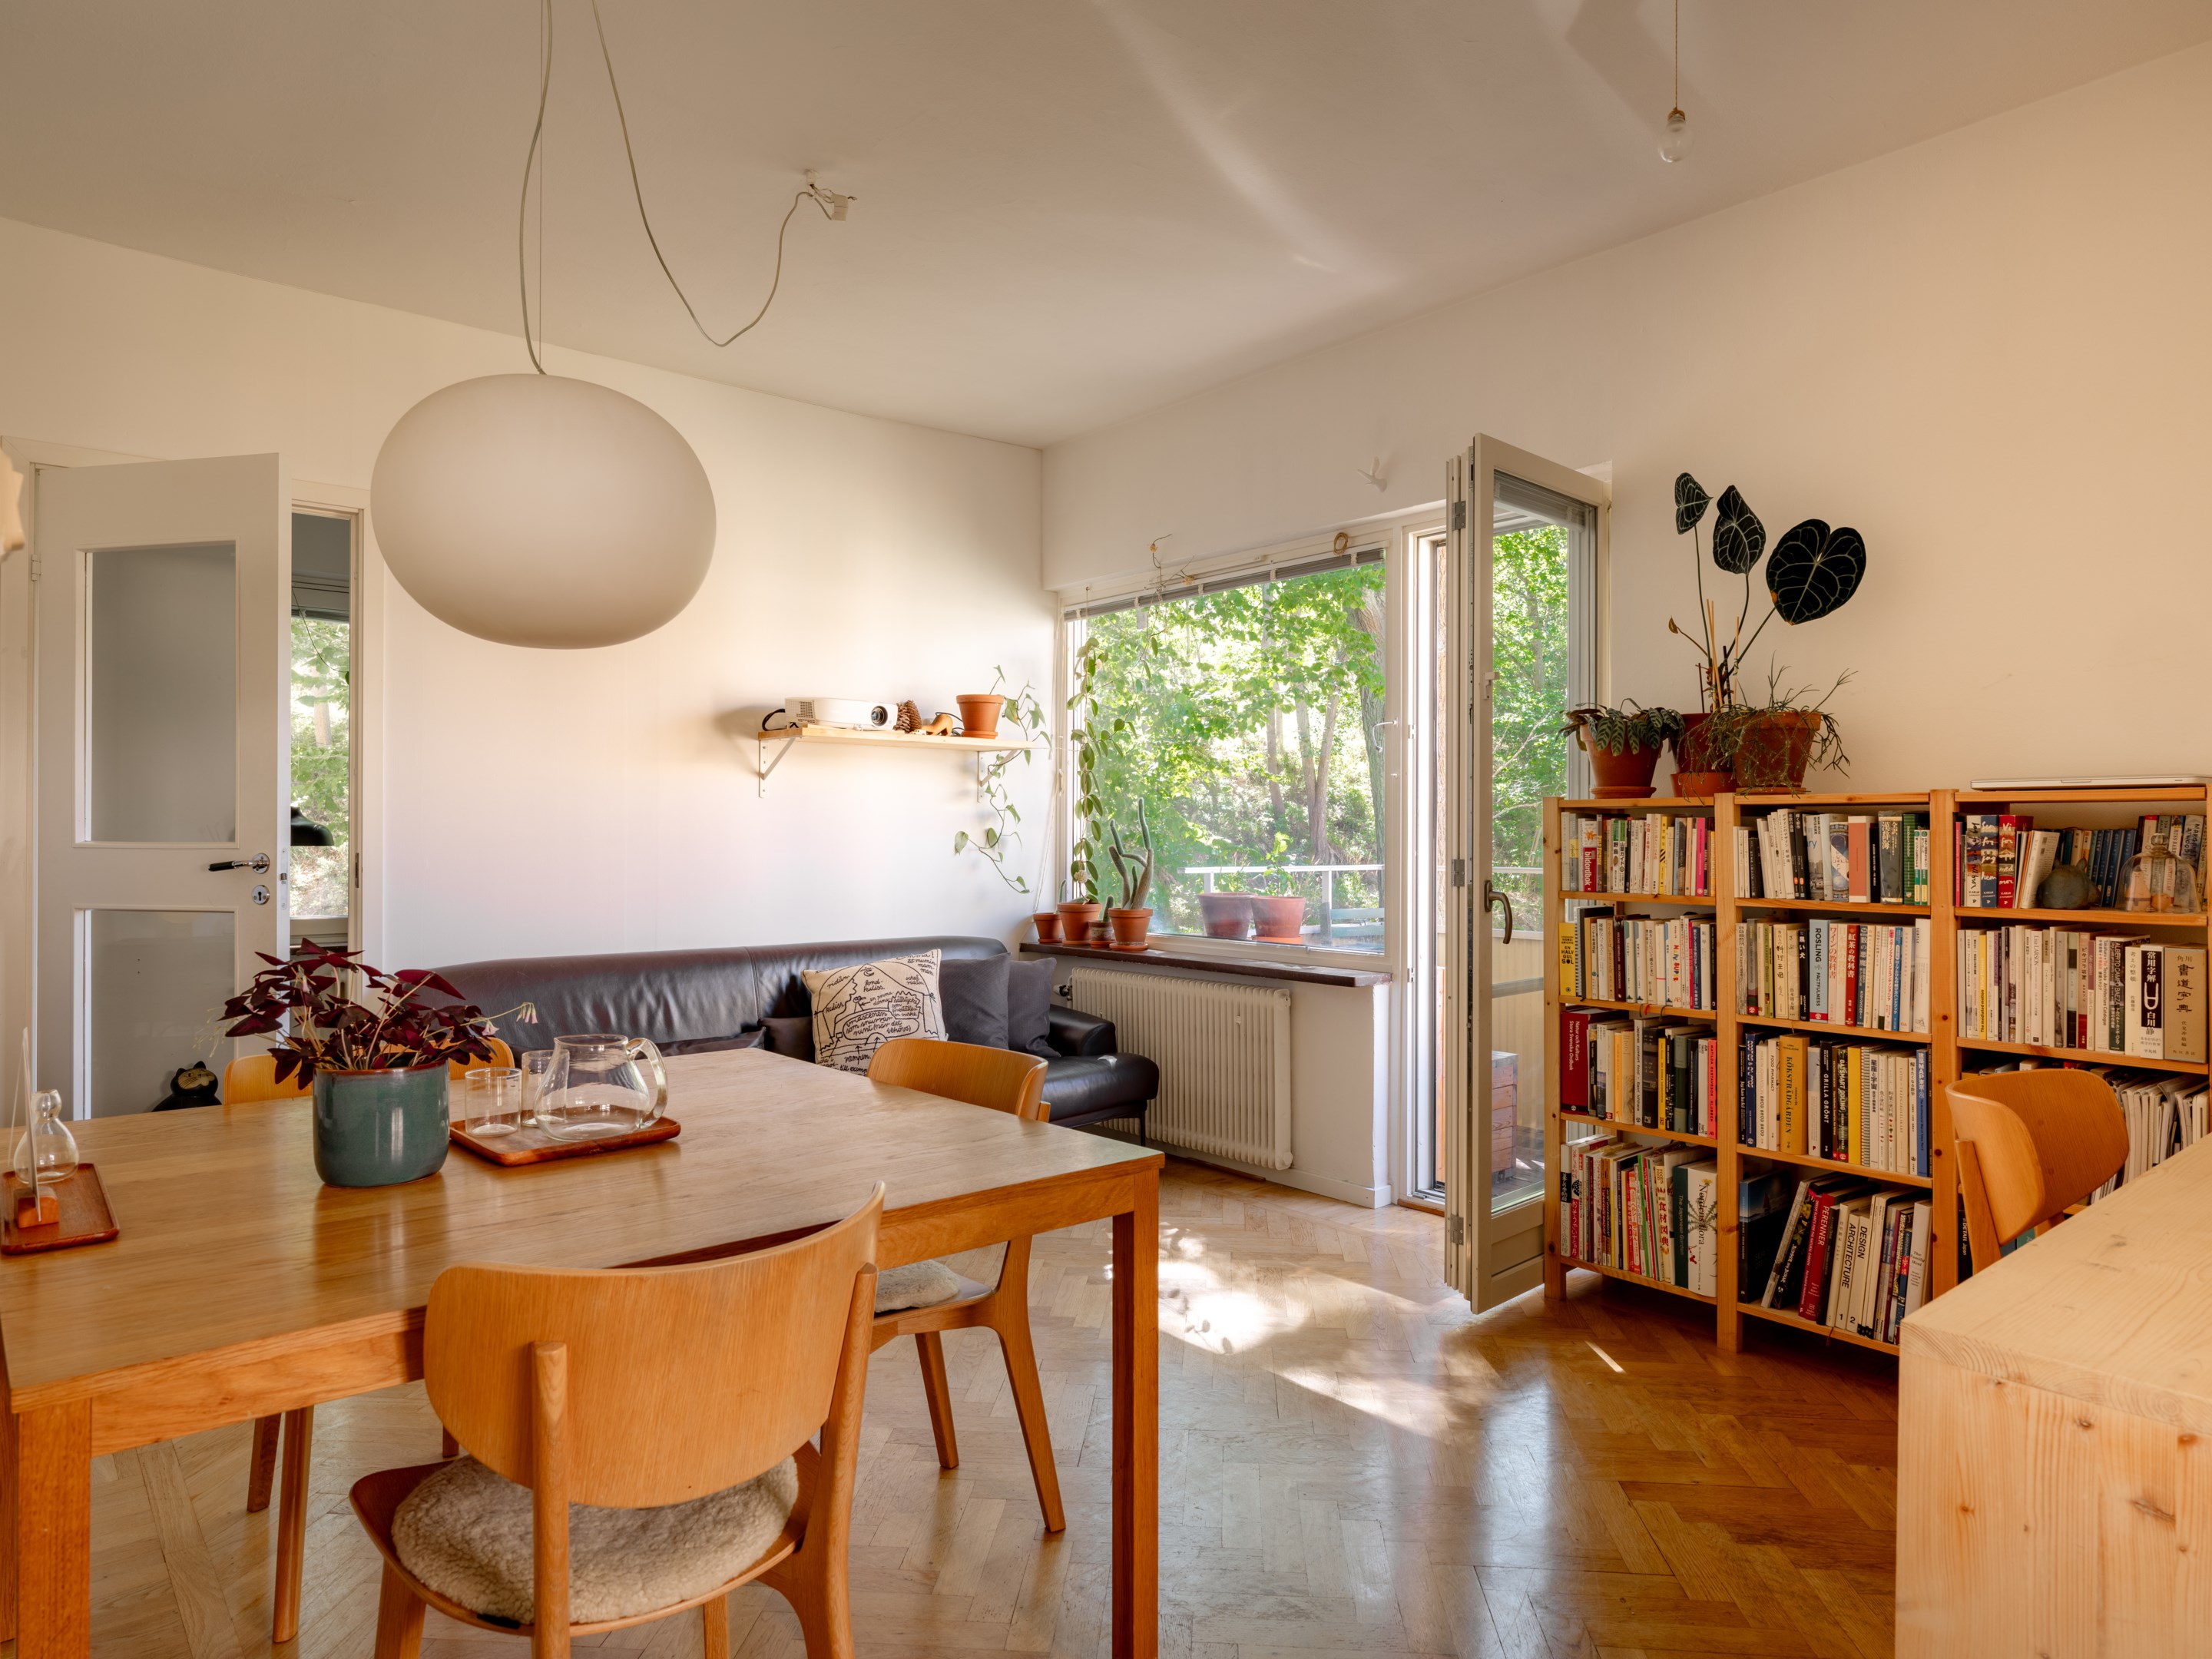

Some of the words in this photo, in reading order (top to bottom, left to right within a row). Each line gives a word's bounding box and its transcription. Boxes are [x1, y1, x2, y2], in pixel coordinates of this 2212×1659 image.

[2002, 822, 2012, 831] Vi
[1981, 872, 1996, 880] hem
[1847, 933, 1856, 979] 紅茶の教科書
[2147, 951, 2157, 982] 常用字解
[846, 1025, 859, 1034] som
[860, 1017, 892, 1028] snurrar
[2146, 1012, 2156, 1035] 白川静
[1785, 1056, 1793, 1134] KÖKSTRÄDGÅRDEN
[1698, 1184, 1707, 1223] Nordens
[1658, 1201, 1669, 1247] 食材図典
[1698, 1223, 1707, 1245] flora
[1818, 1205, 1830, 1246] PERENNER
[1842, 1223, 1856, 1289] ARCHITECTURE
[1857, 1226, 1867, 1259] DESIGN
